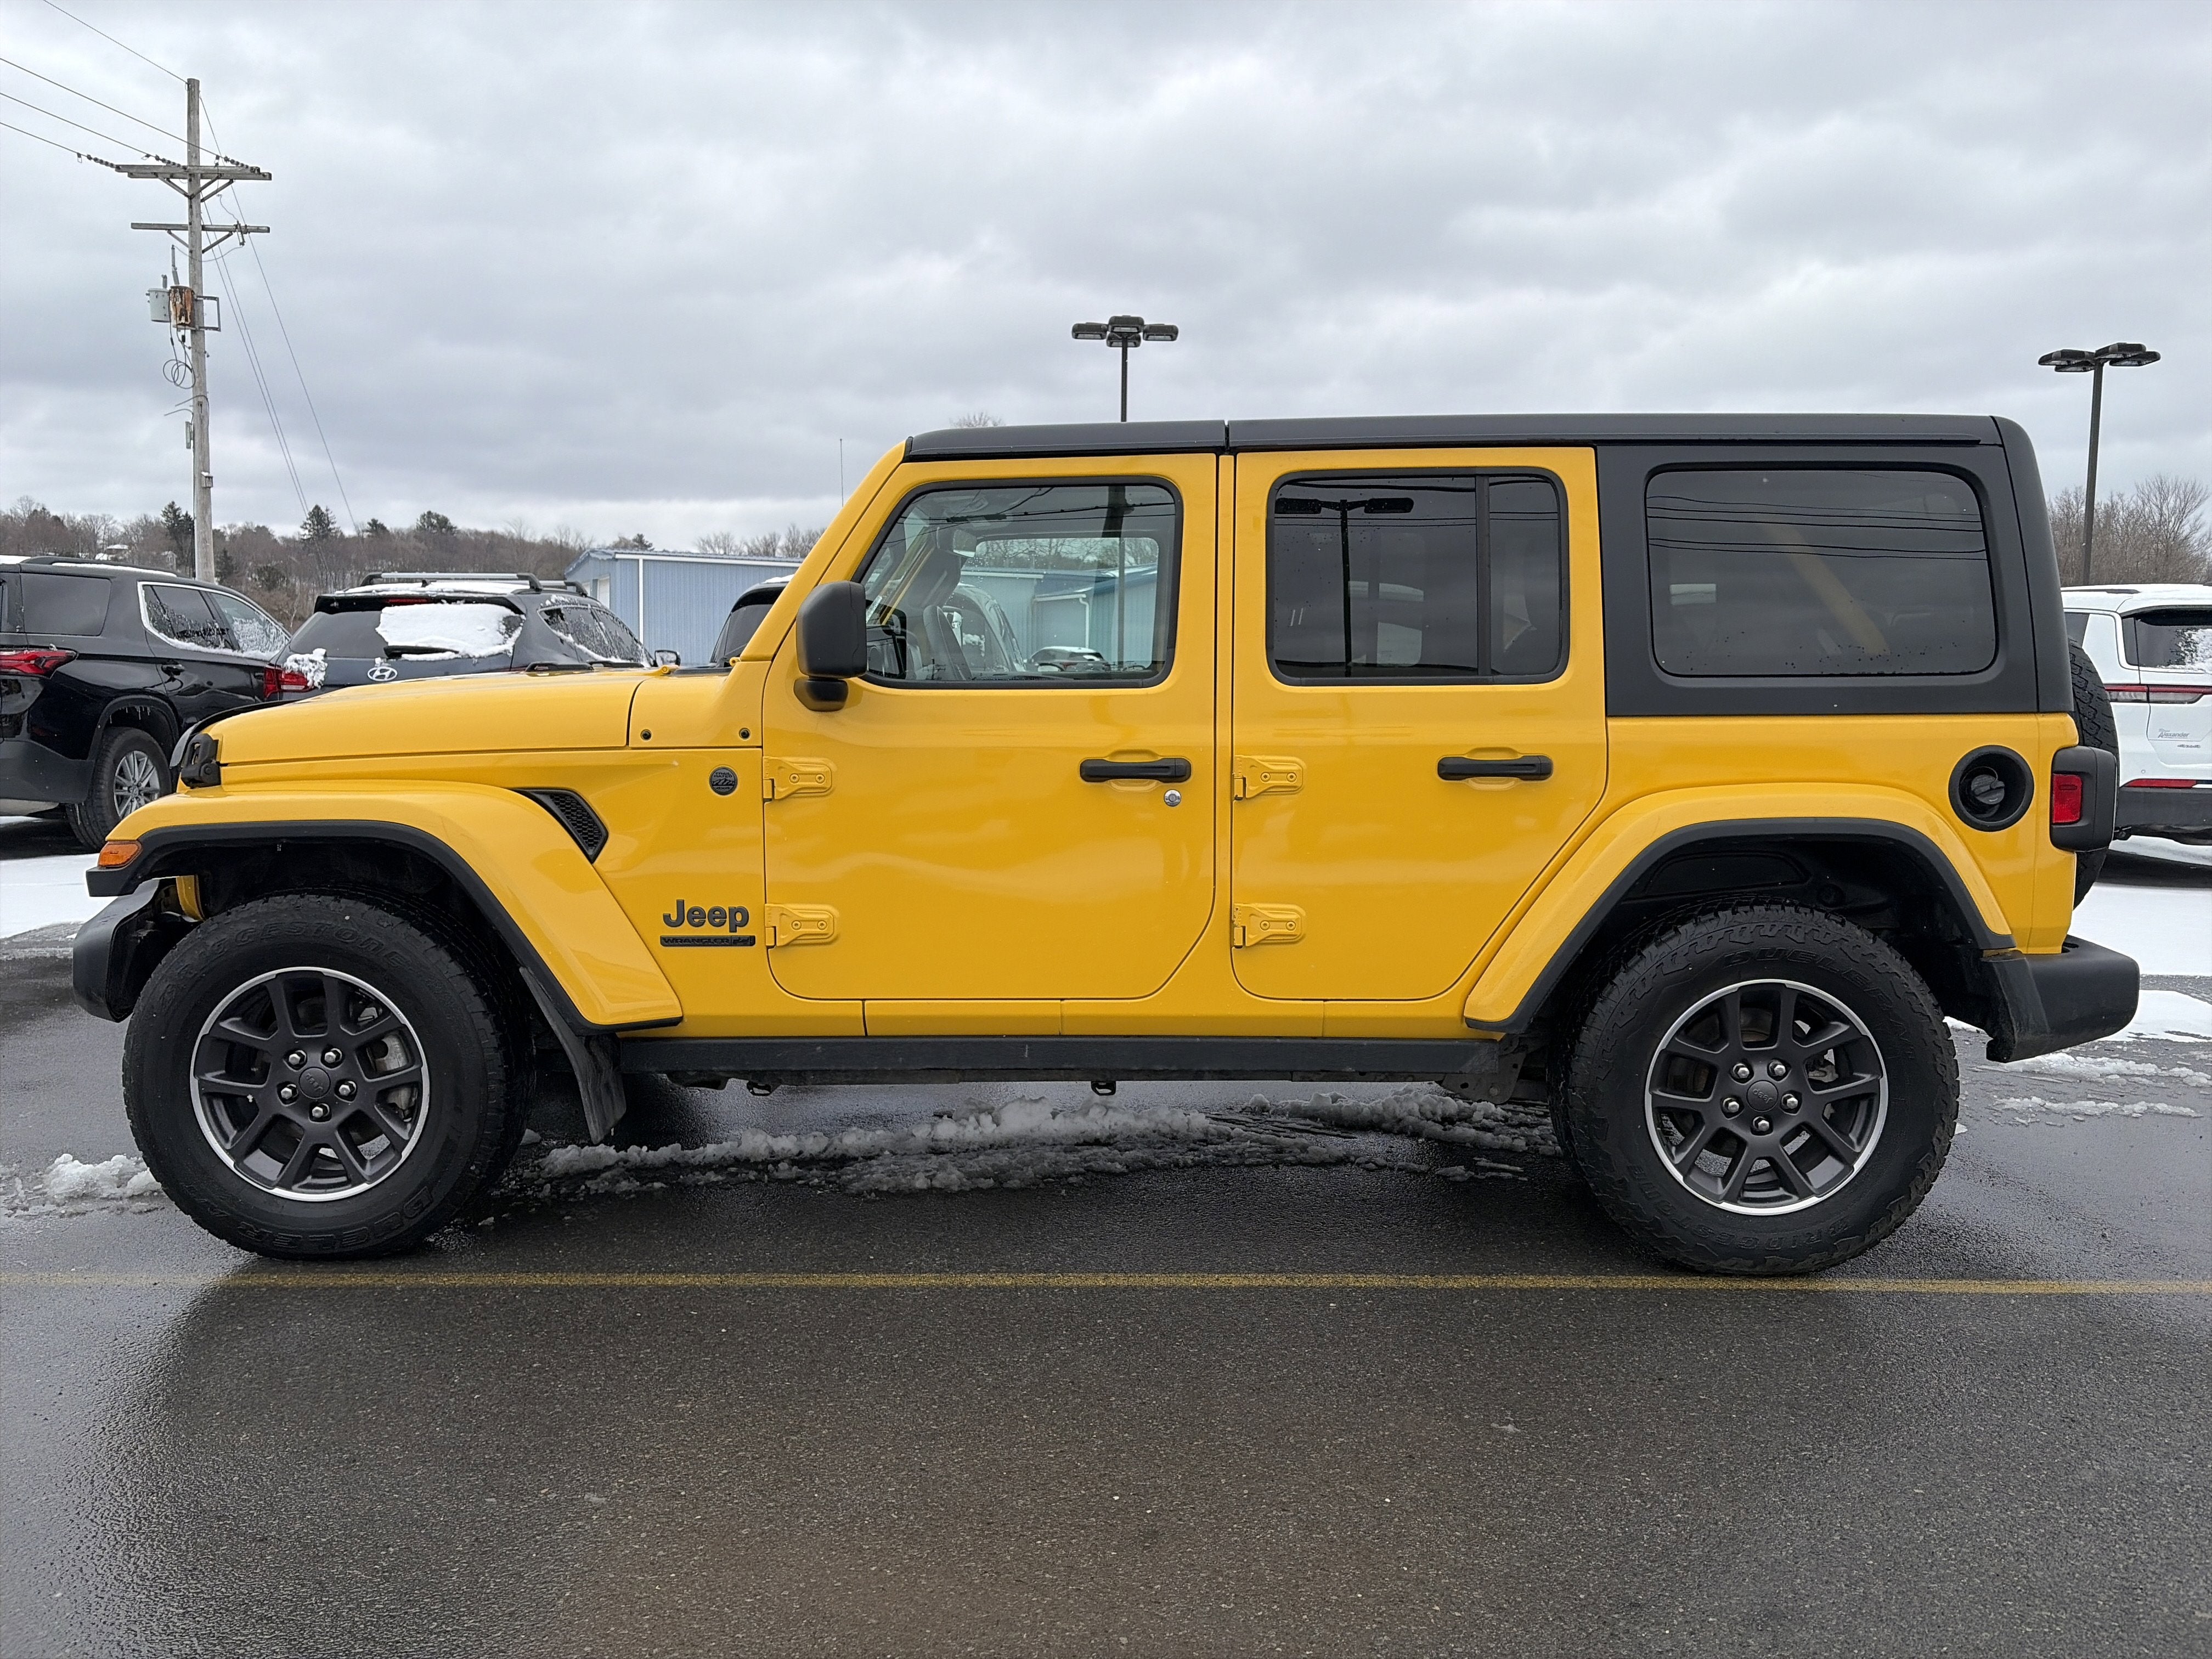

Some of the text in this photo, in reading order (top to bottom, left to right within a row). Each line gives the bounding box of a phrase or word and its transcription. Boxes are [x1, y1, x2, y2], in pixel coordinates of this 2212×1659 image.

[663, 899, 749, 933] Jeep
[1723, 946, 1894, 1013] DUELER
[306, 1073, 323, 1091] Jeep
[1752, 1088, 1773, 1104] Jeep
